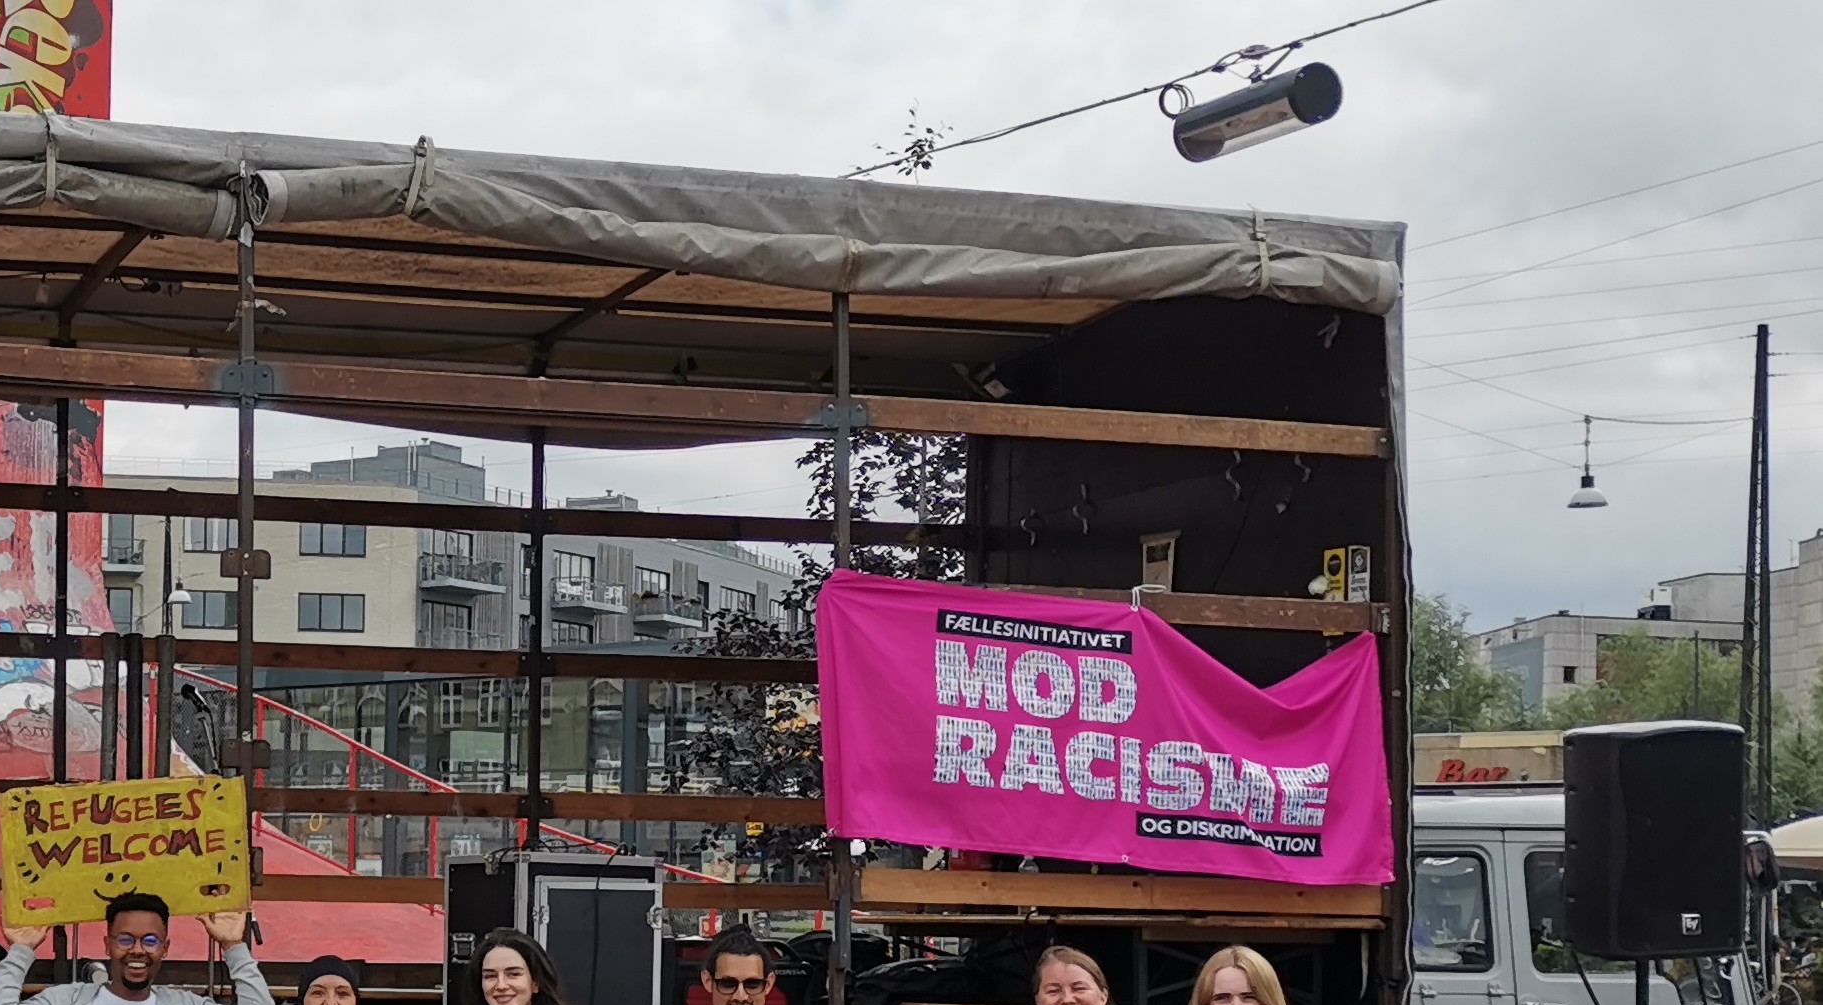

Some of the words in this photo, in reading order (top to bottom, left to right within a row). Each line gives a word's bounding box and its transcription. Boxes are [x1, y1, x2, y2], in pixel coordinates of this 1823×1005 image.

[944, 612, 1126, 651] FÆLLESINITIATIVET
[935, 639, 1137, 724] MOD
[932, 715, 1330, 827] RACISME
[1435, 758, 1510, 783] Bar
[24, 788, 206, 836] REFUGEES
[1141, 817, 1172, 834] OG
[28, 828, 226, 869] WELCOME
